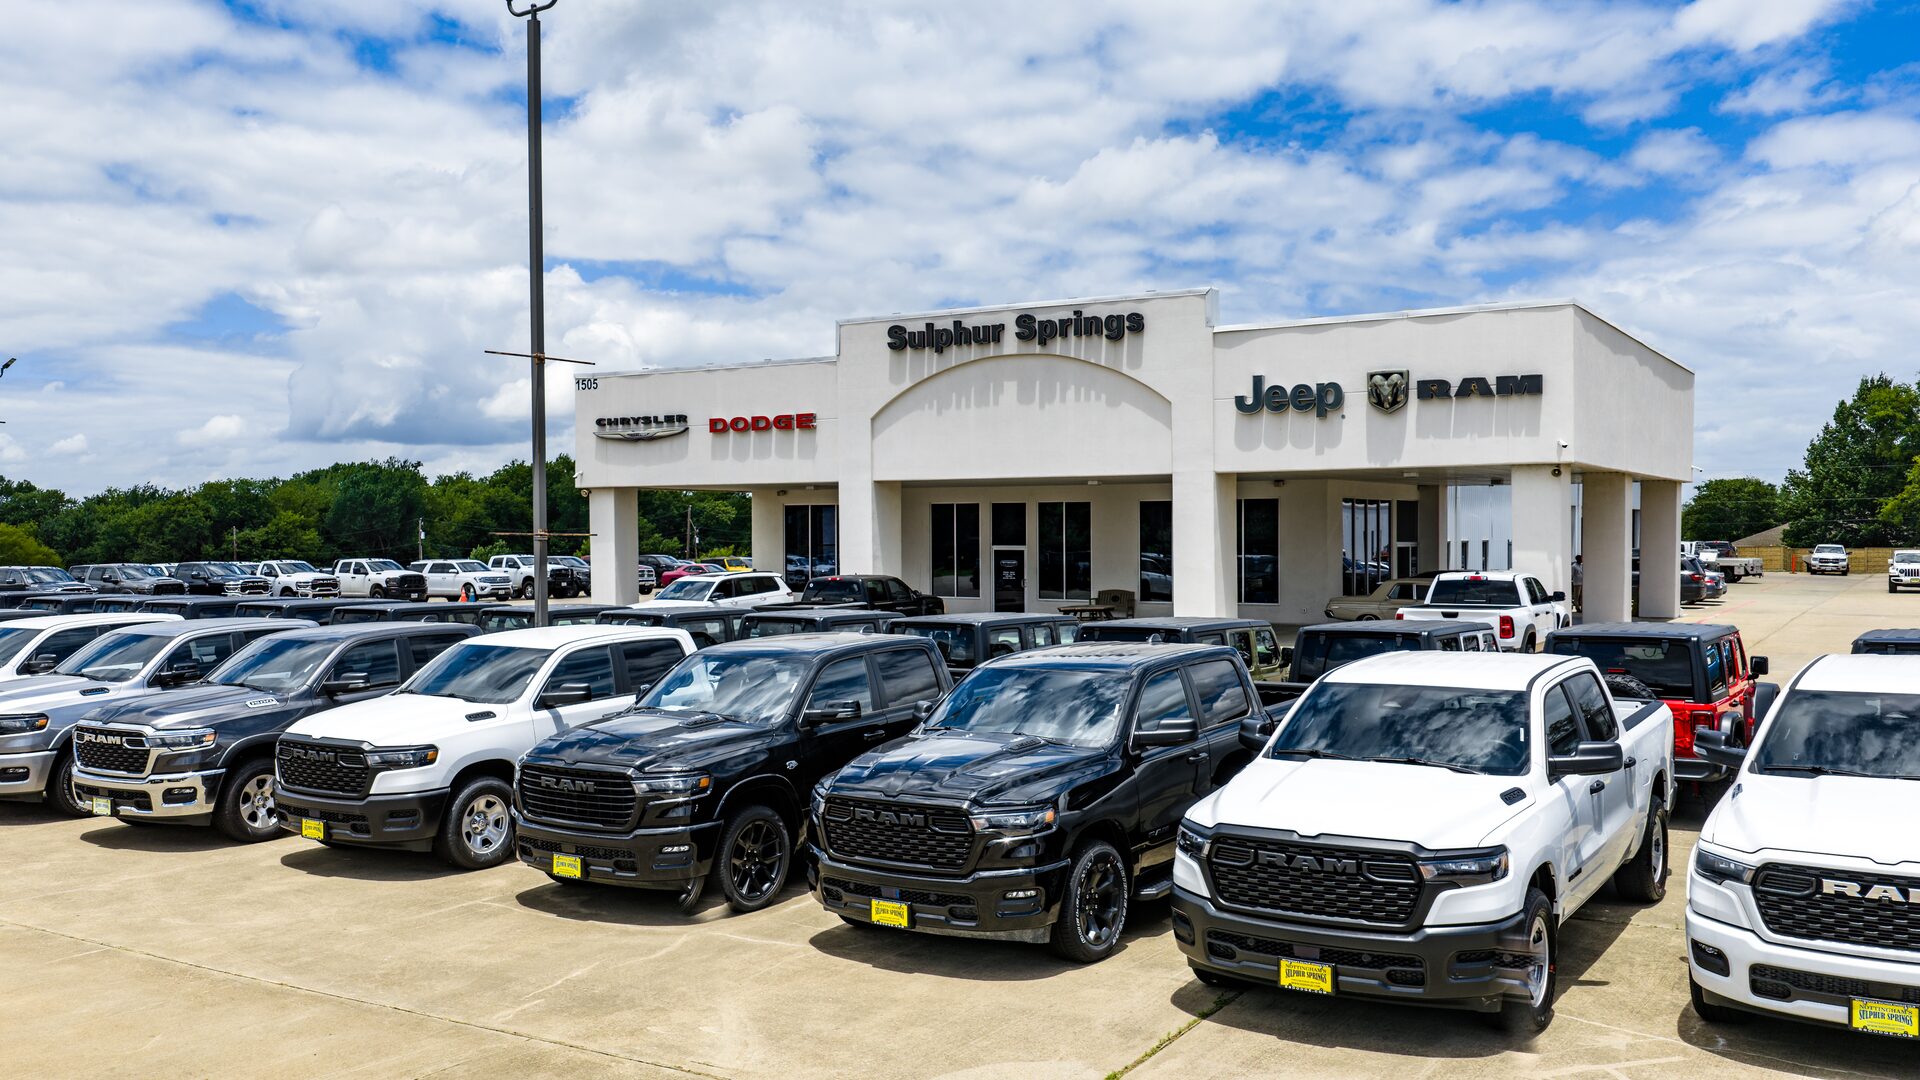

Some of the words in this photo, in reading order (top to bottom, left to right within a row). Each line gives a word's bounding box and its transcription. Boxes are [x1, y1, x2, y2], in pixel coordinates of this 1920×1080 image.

[887, 320, 1005, 353] Sulphur
[1015, 310, 1145, 346] Springs
[575, 378, 598, 391] 1505
[1417, 374, 1543, 399] RAM
[1235, 375, 1345, 419] Jeep
[595, 414, 688, 427] CHRYSLER
[709, 412, 816, 433] DODGE
[84, 733, 121, 745] RAM
[292, 748, 336, 762] RAM
[541, 776, 595, 792] RAM
[855, 807, 925, 826] RAM
[1258, 850, 1357, 874] RAM
[1285, 969, 1305, 978] SULPHUR
[1307, 971, 1327, 984] SPRINGS
[1859, 1010, 1885, 1020] SULPHUR
[1888, 1012, 1913, 1026] SPRINGS
